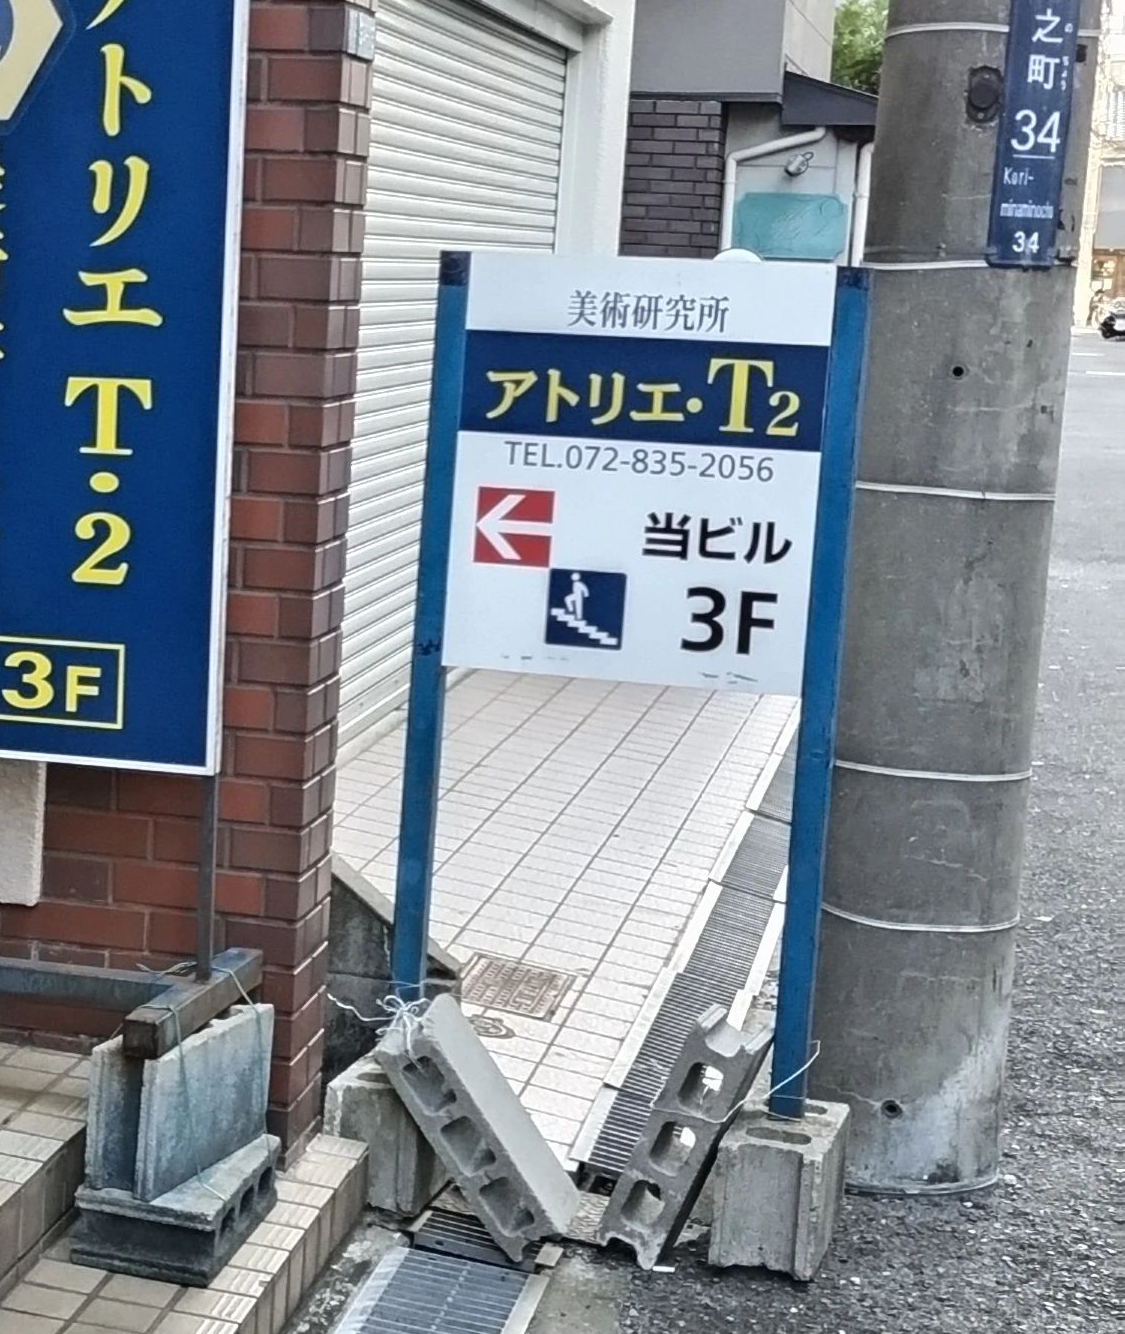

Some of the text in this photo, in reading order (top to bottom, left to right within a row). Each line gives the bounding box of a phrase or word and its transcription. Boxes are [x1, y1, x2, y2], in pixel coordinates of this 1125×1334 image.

[1010, 108, 1061, 153] 34
[1011, 231, 1040, 253] 34
[566, 289, 730, 334] 美術研究所
[504, 440, 774, 482] TEL.072-835-2056
[642, 512, 793, 564] 当ビル
[680, 586, 779, 656] 3F
[2, 651, 102, 713] 3F
